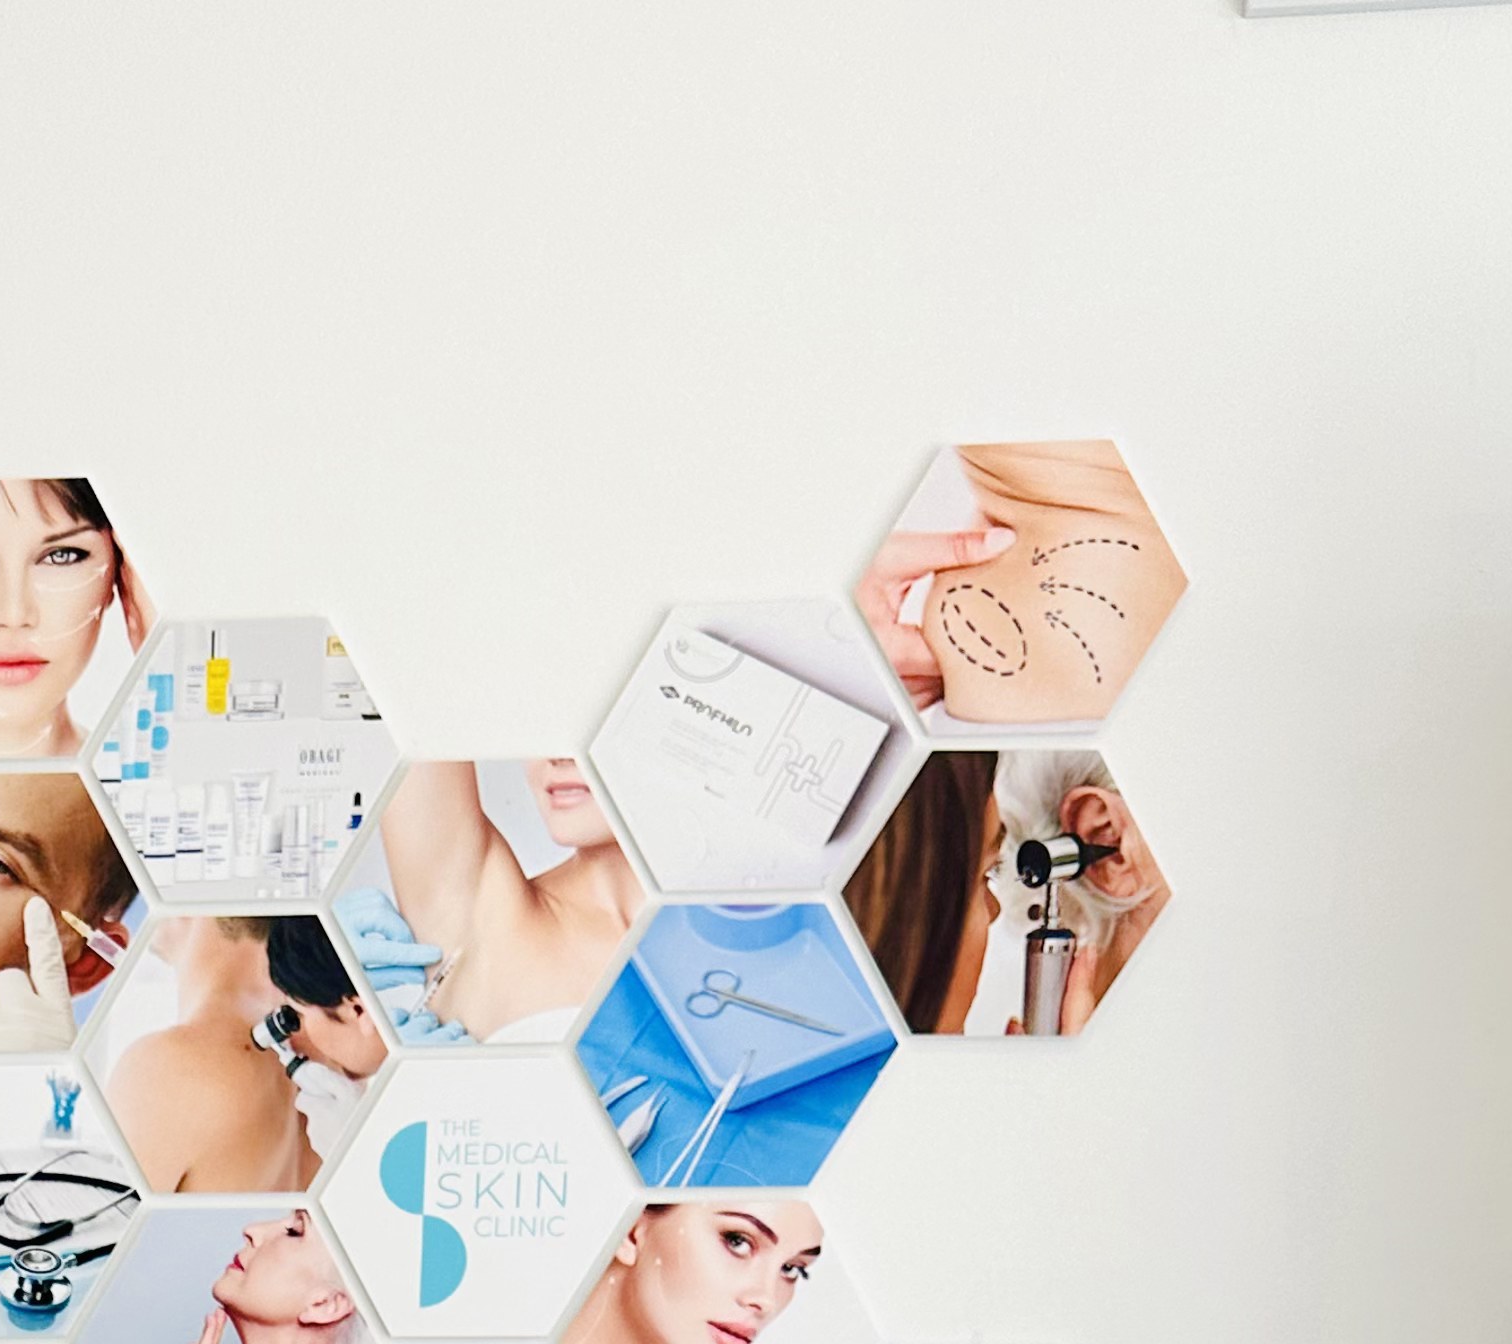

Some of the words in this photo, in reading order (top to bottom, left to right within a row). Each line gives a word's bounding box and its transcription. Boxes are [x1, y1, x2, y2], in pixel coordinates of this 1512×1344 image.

[440, 1119, 482, 1136] THE
[437, 1141, 568, 1165] MEDICAL
[435, 1171, 568, 1210] SKIN
[473, 1216, 566, 1237] CLINIC
